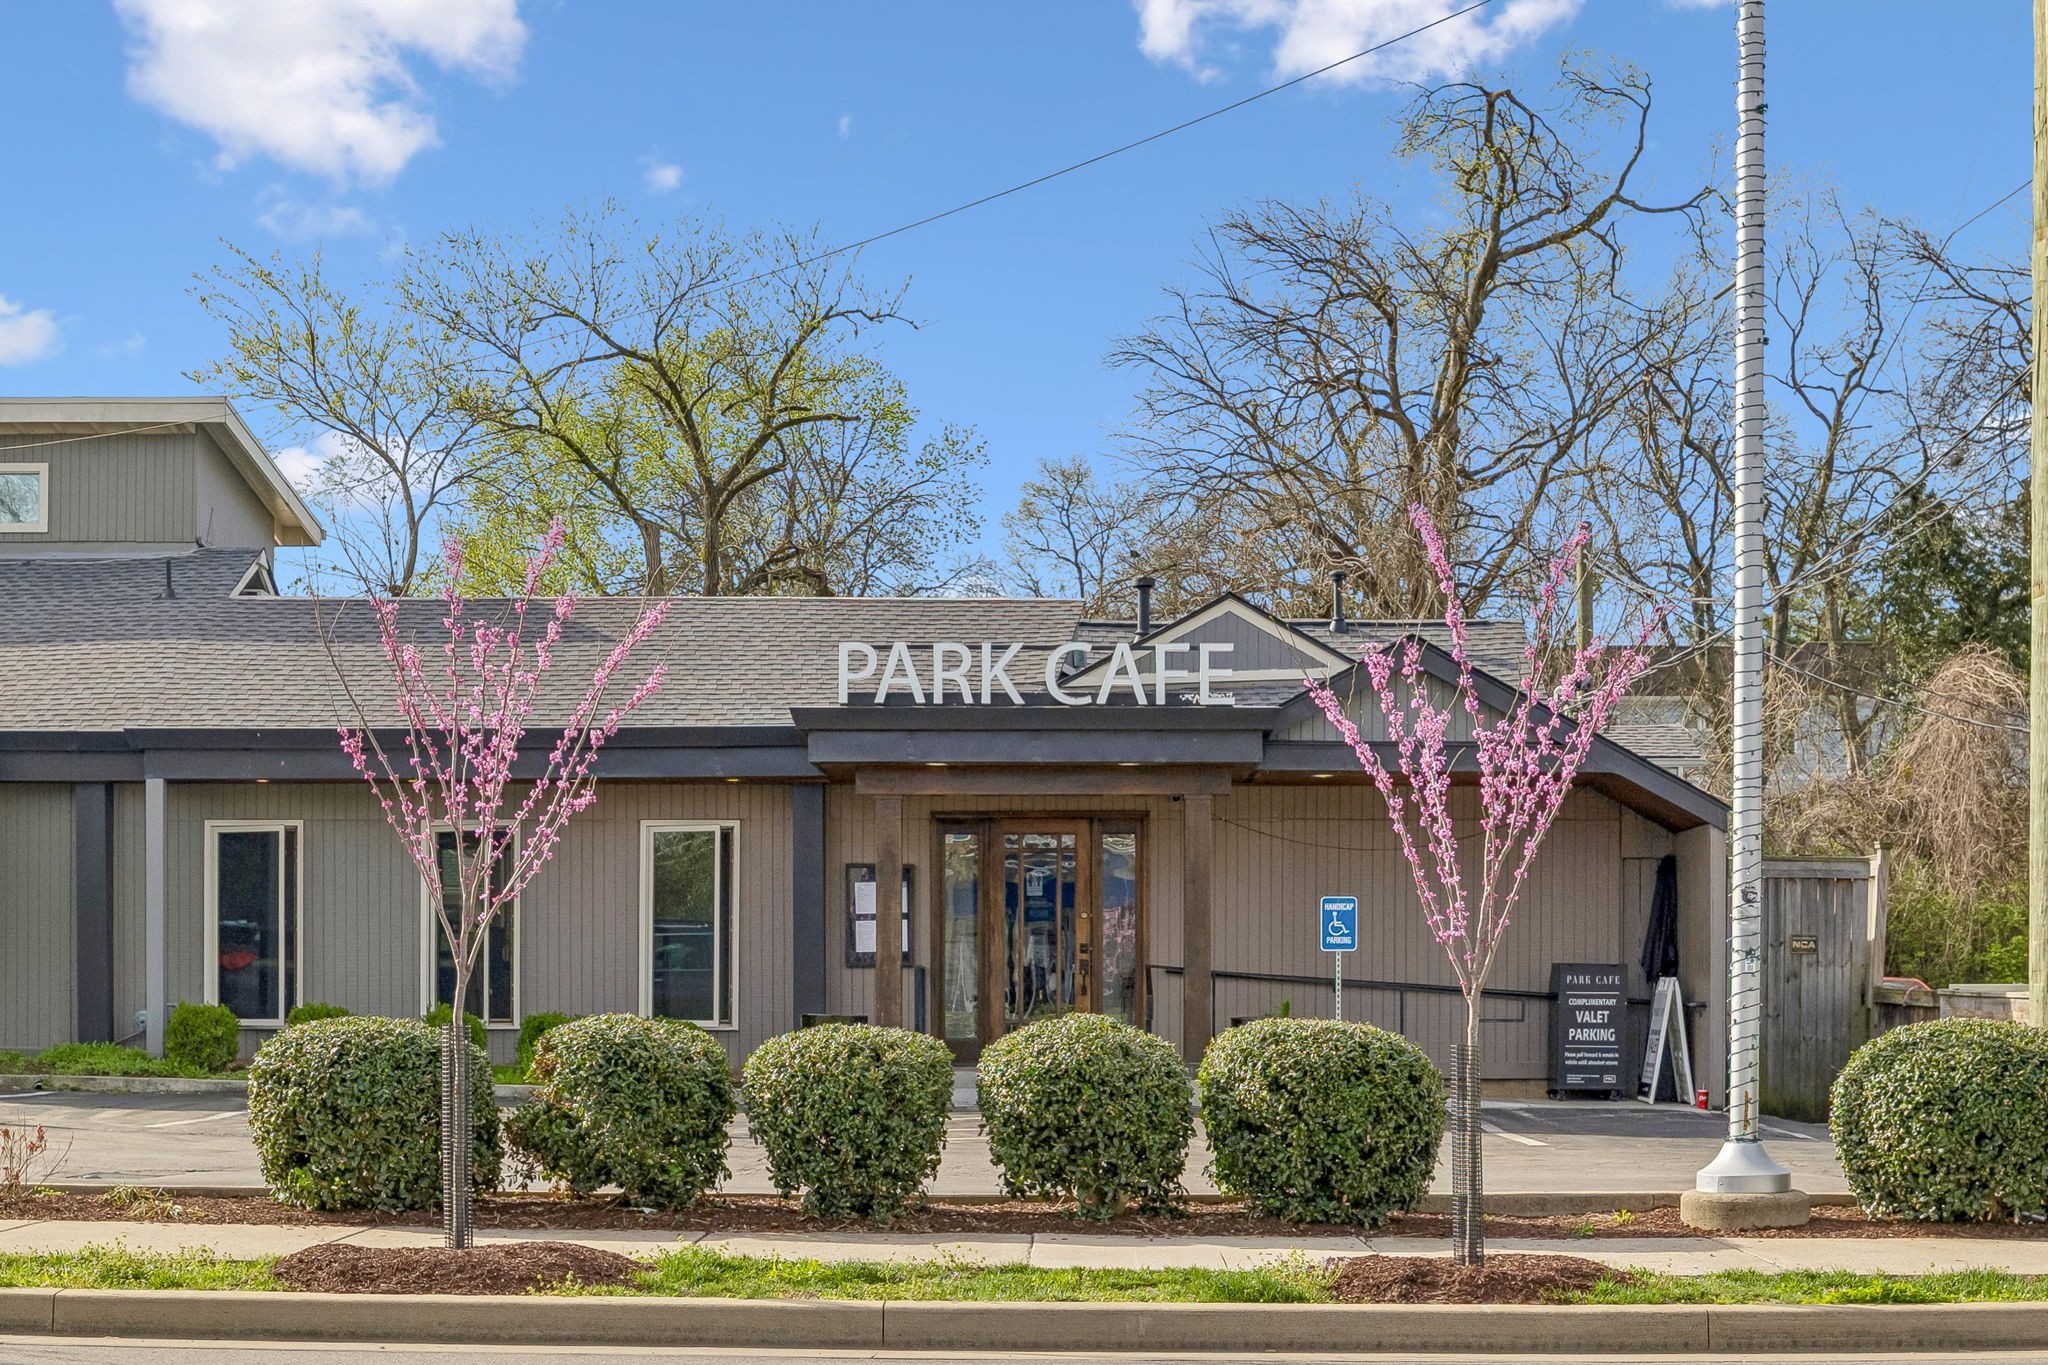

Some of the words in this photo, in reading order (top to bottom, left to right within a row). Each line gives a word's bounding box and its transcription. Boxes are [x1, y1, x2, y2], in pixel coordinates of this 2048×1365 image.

[838, 641, 1026, 706] PARK
[1045, 641, 1236, 706] CAFE
[1324, 902, 1354, 911] HANDICAP
[1326, 936, 1352, 944] PARKING
[1792, 940, 1816, 949] NCA
[1566, 974, 1591, 985] PARK
[1595, 975, 1621, 985] CAFE
[1568, 998, 1617, 1006] COMPLIMENTARY
[1575, 1010, 1610, 1024] VALET
[1568, 1028, 1616, 1041] PARKING
